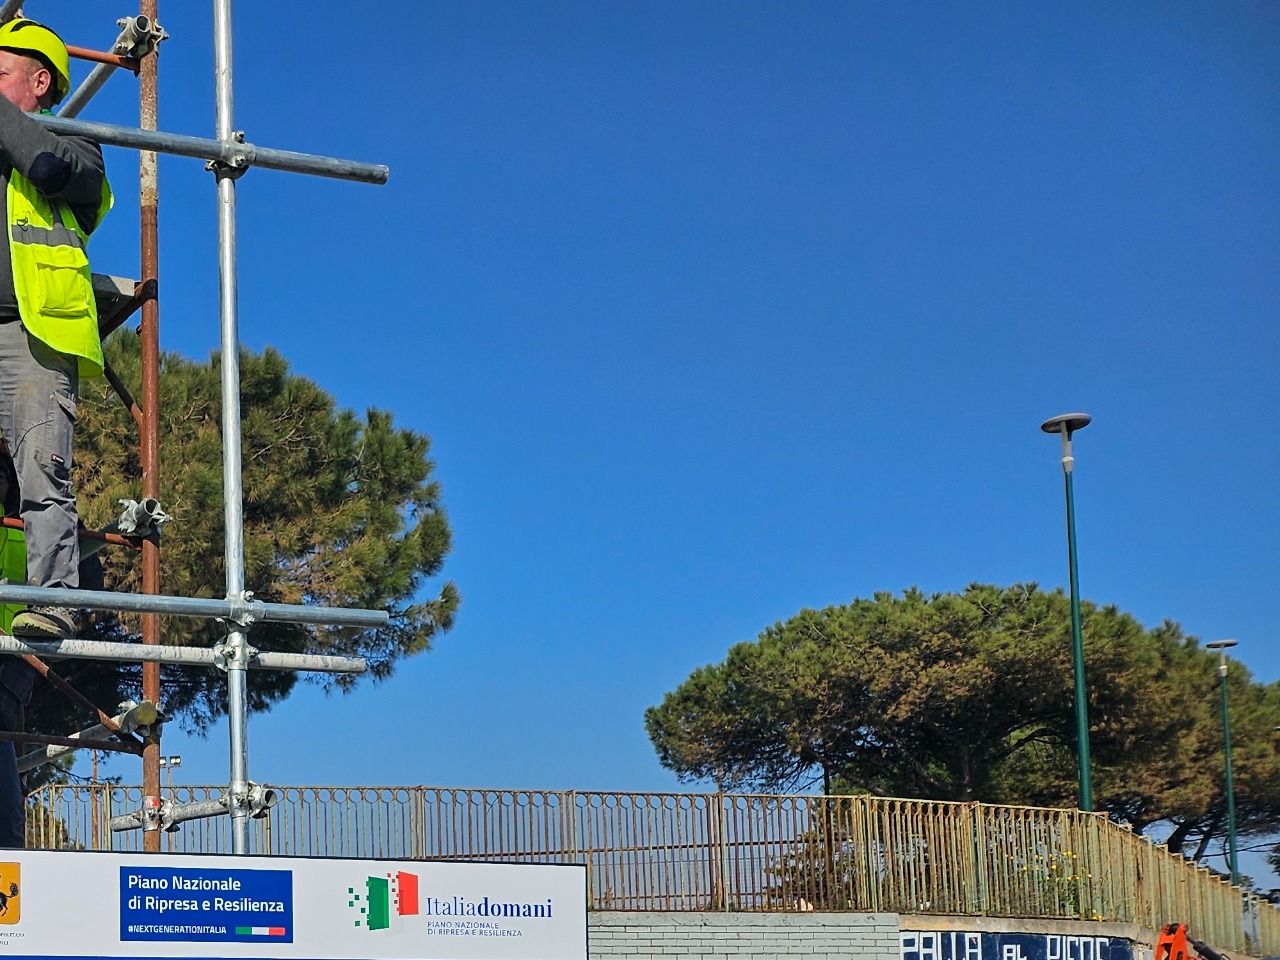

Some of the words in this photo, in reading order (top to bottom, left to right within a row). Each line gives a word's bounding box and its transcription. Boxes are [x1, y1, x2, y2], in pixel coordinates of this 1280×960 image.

[128, 875, 168, 890] Piano
[172, 875, 241, 891] Nazionale
[128, 895, 141, 910] di
[145, 896, 199, 914] Ripresa
[202, 900, 211, 911] e
[214, 897, 285, 912] Resilienza
[426, 896, 552, 918] Italiadomani
[128, 924, 227, 934] #NEXTGENERATIONITALIA
[454, 921, 499, 930] NAZIONALE
[438, 928, 470, 936] RIPRESA
[471, 928, 477, 936] E
[478, 929, 523, 937] RESILIENZA
